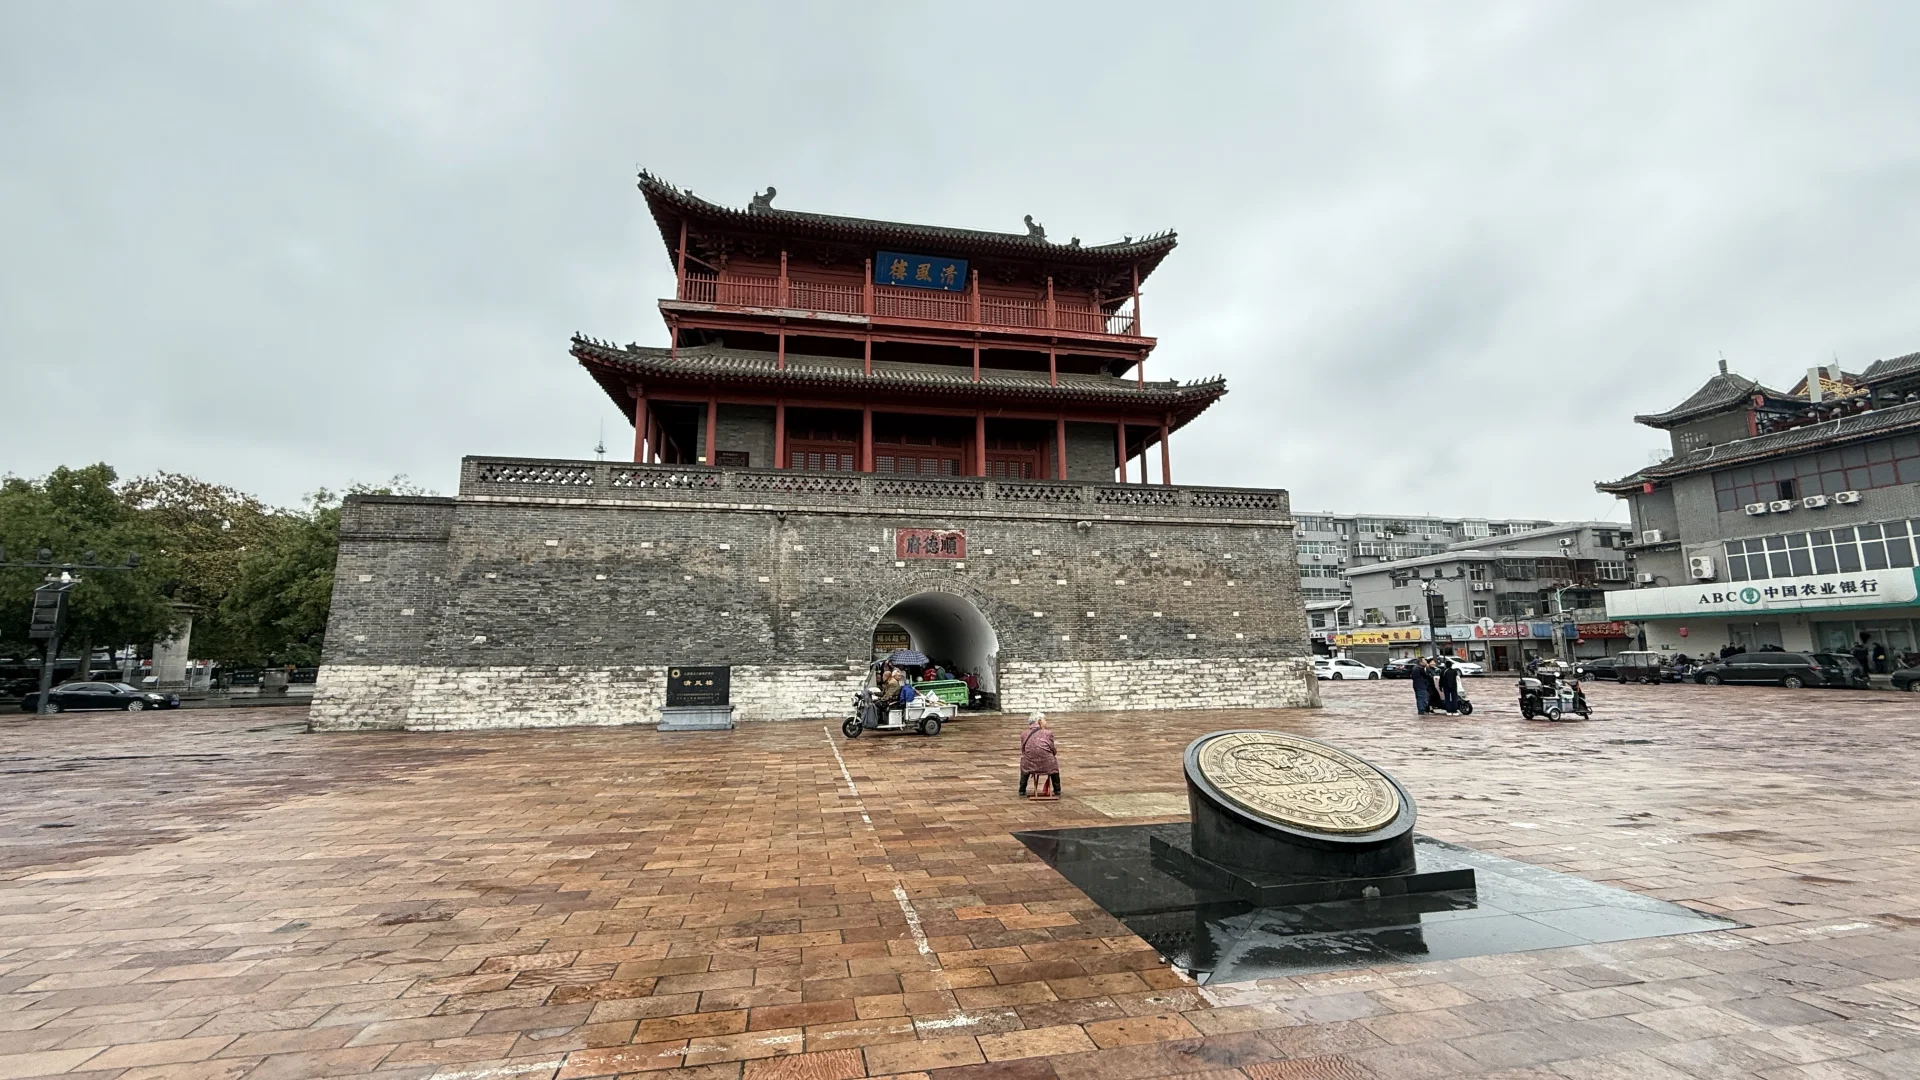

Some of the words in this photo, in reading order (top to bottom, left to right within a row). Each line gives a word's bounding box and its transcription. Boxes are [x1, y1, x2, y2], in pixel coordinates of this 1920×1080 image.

[1698, 591, 1737, 605] ABC
[1764, 579, 1878, 599] 中国农业银行
